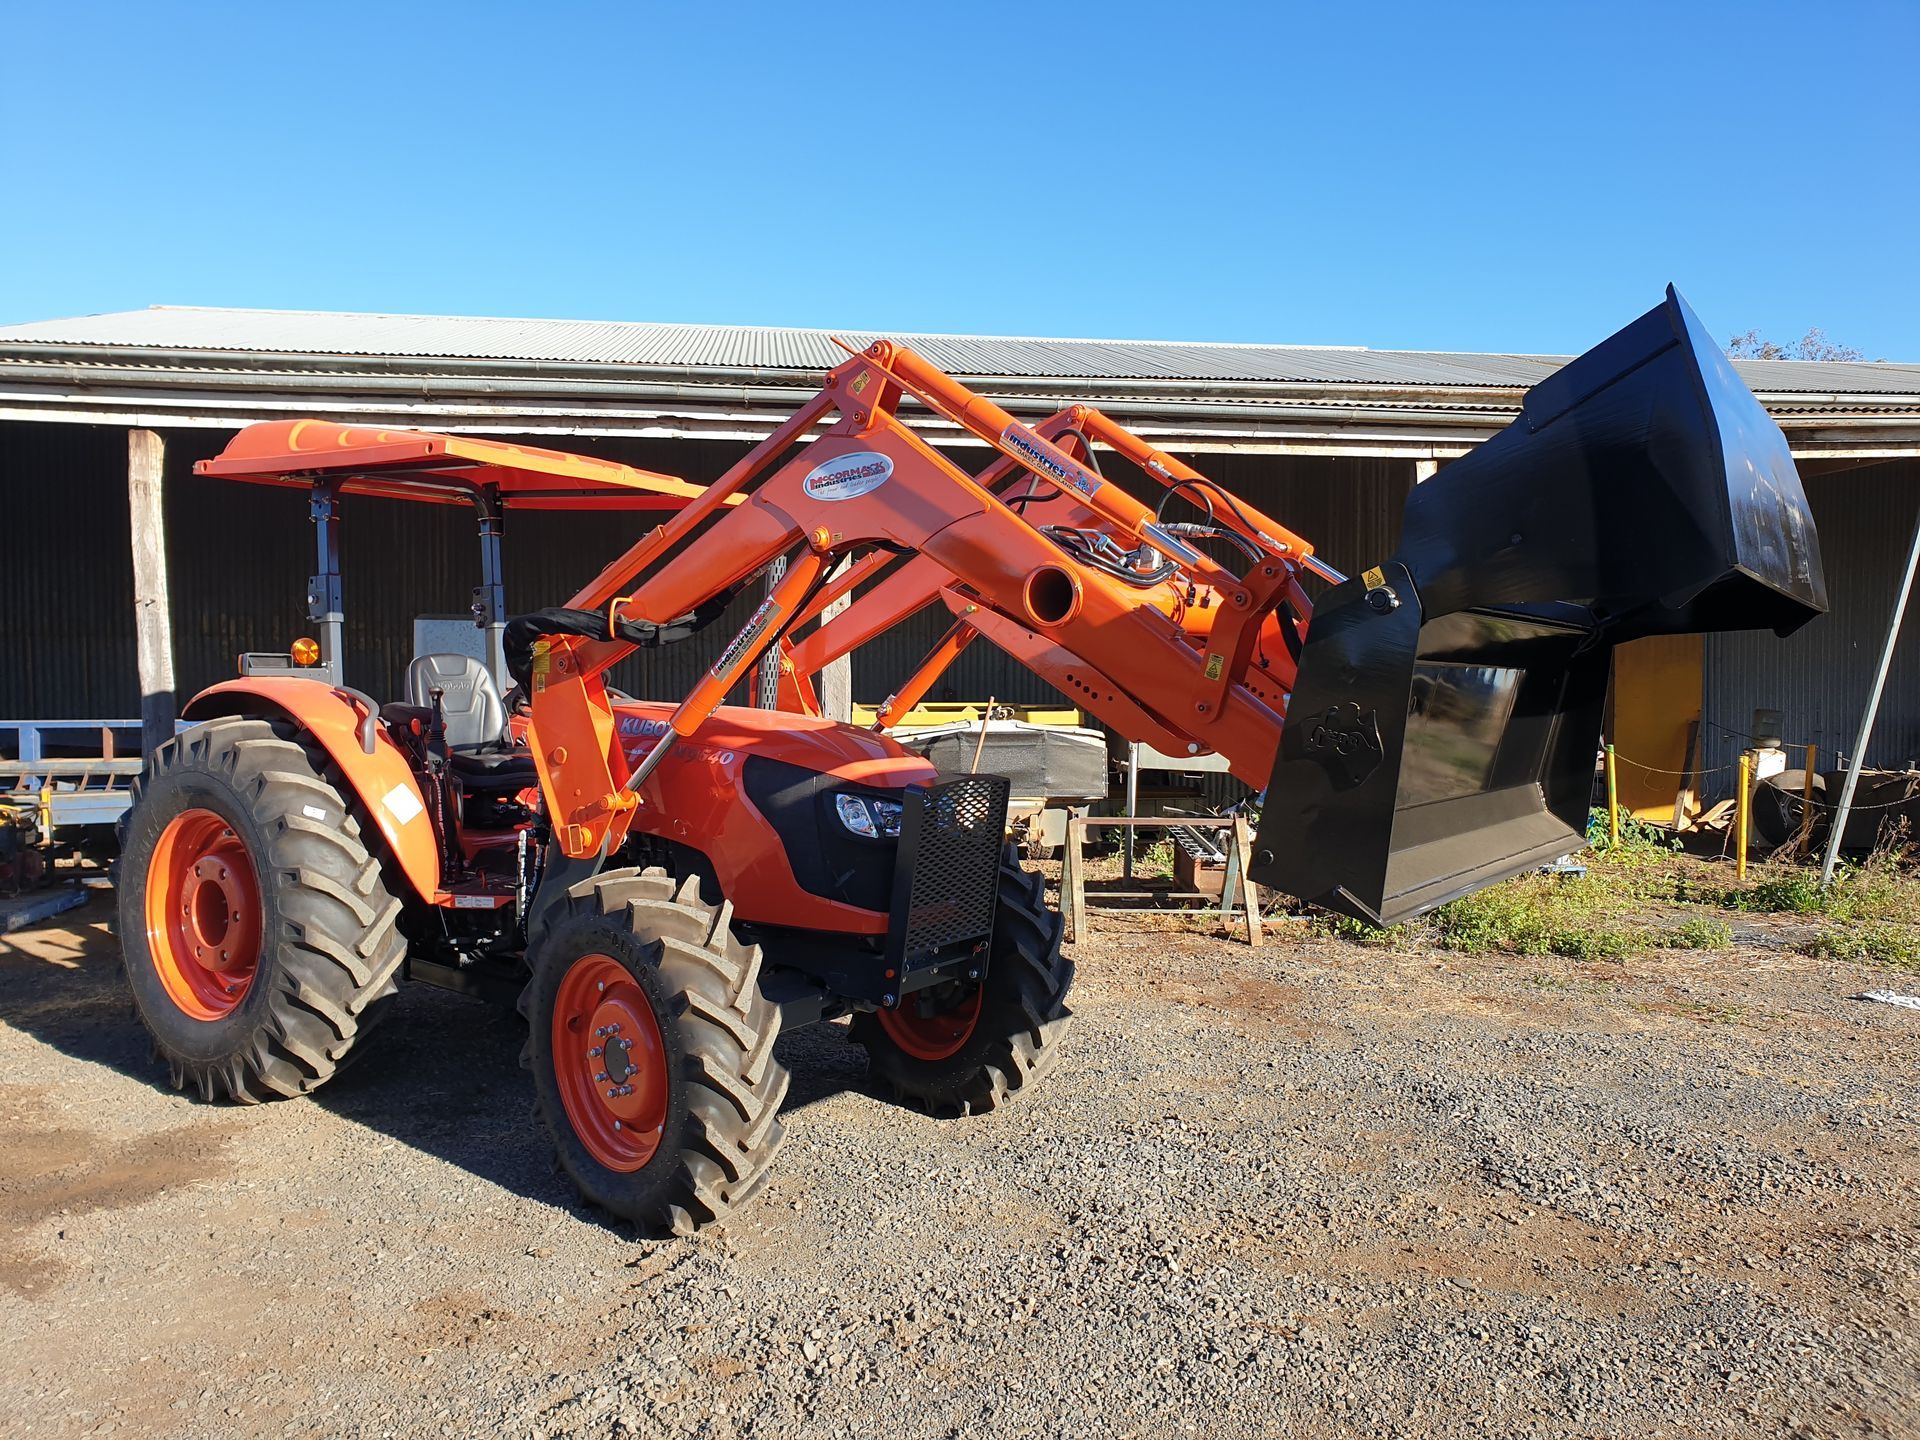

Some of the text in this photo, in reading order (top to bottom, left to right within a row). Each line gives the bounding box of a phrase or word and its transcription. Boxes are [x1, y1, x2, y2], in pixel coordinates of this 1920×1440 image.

[1008, 434, 1066, 478] industries
[815, 474, 862, 490] industries
[717, 623, 756, 671] industries
